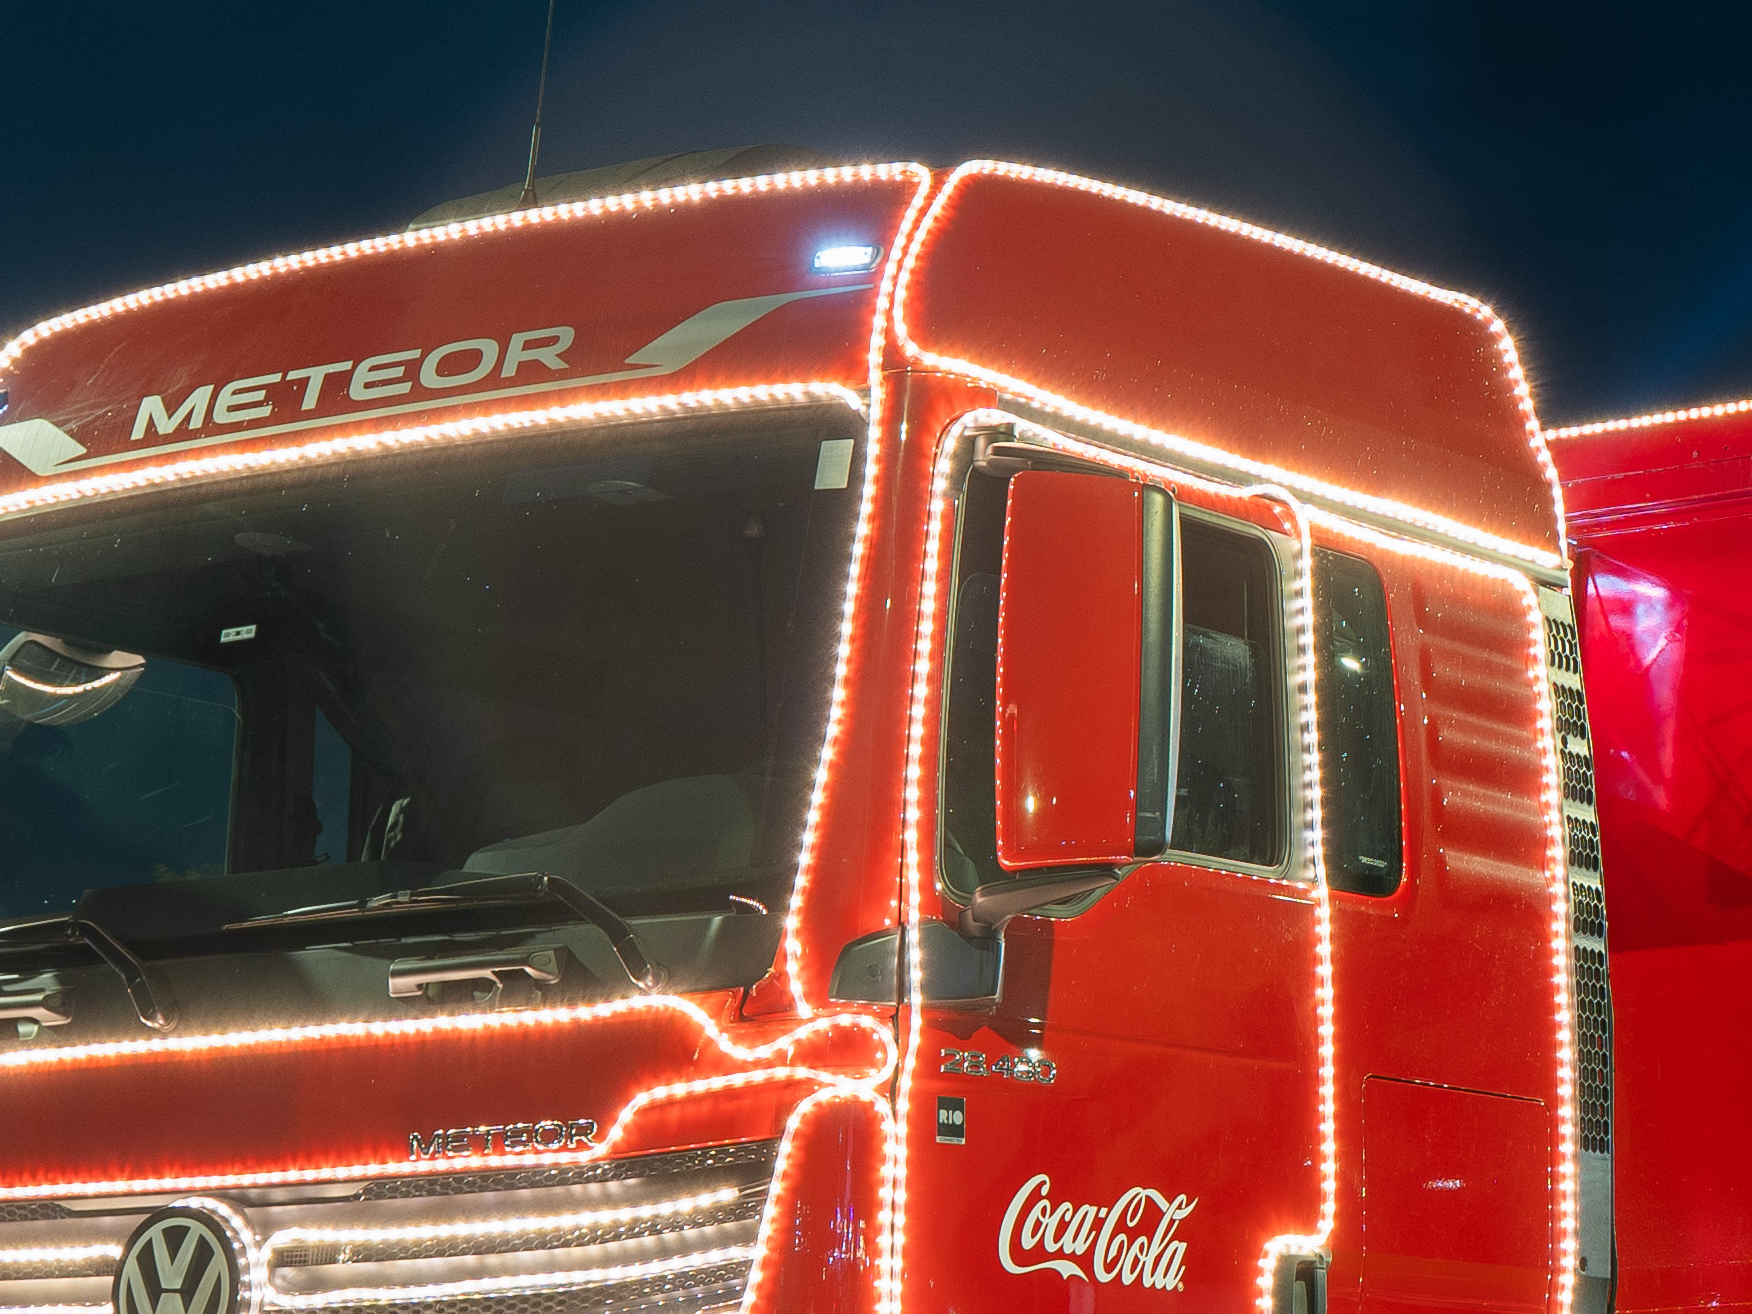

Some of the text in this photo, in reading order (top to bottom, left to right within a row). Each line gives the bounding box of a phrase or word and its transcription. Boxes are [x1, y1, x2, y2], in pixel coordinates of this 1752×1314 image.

[130, 326, 575, 441] METEOR
[408, 1118, 599, 1161] METEOR
[938, 1109, 964, 1125] RIO
[998, 1173, 1199, 1292] Coca-Cola
